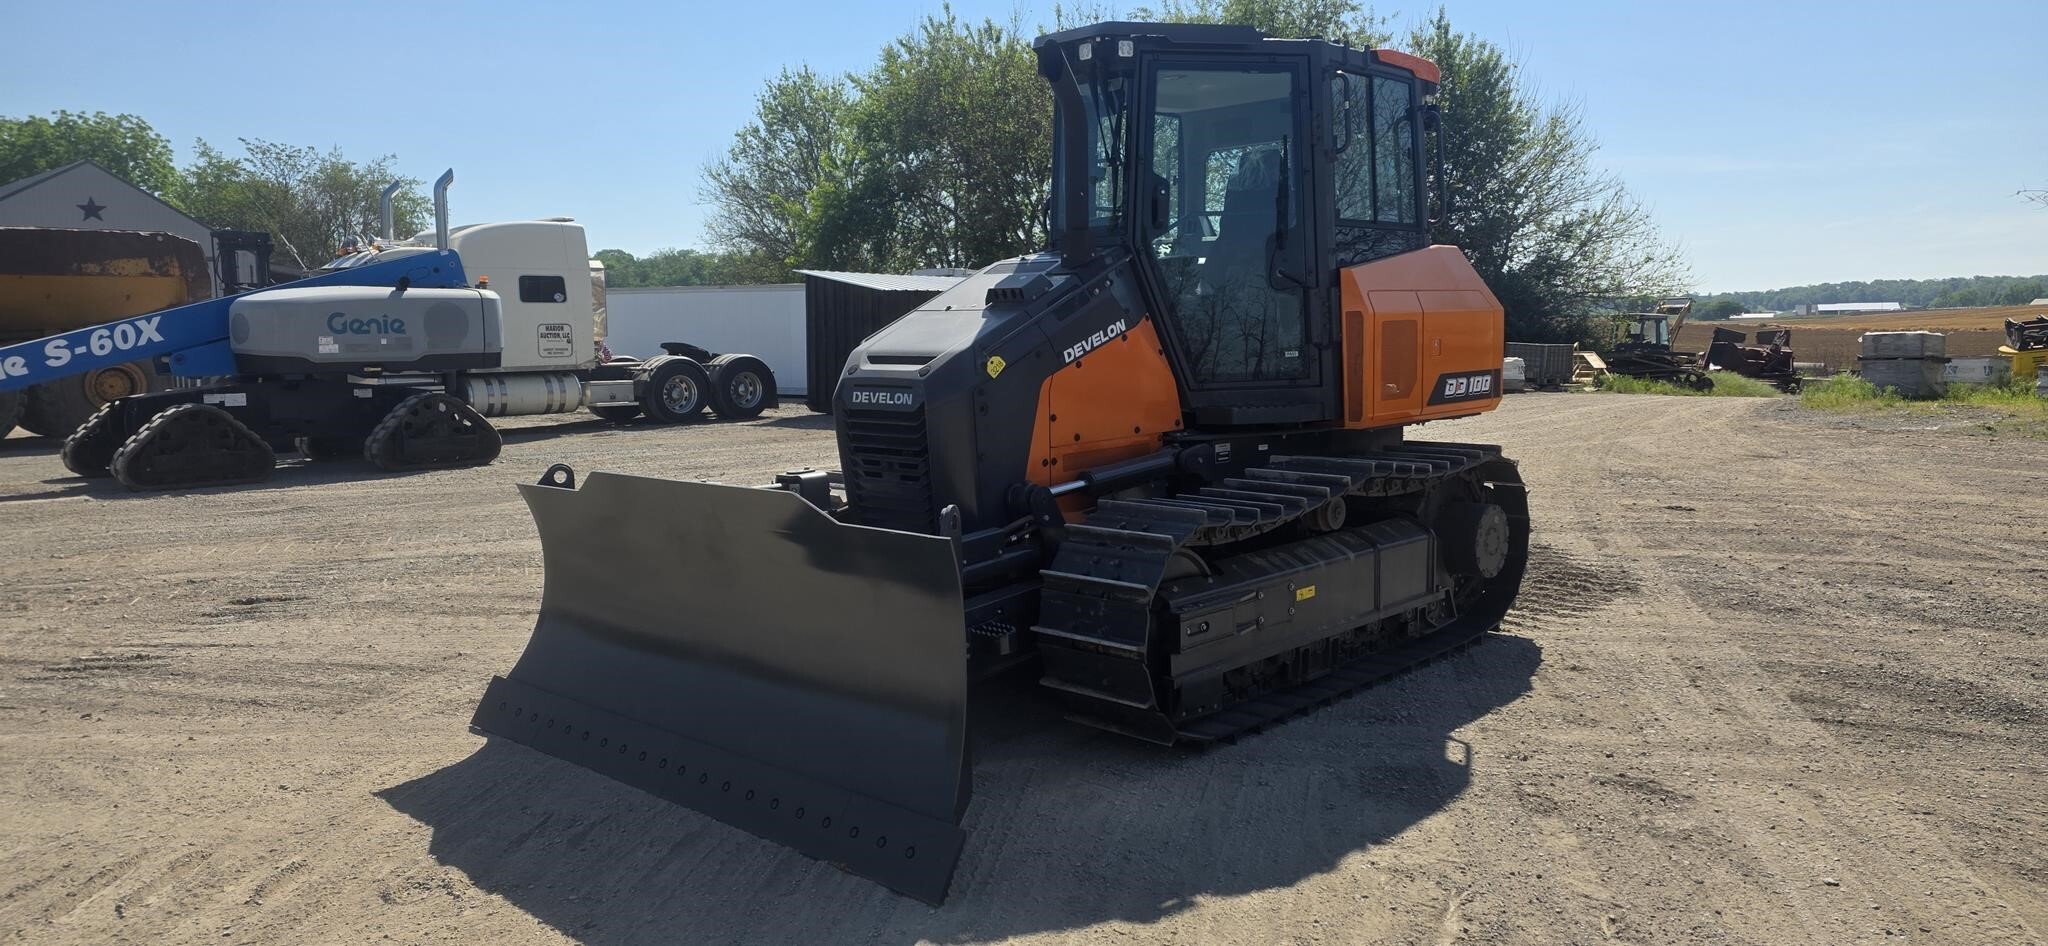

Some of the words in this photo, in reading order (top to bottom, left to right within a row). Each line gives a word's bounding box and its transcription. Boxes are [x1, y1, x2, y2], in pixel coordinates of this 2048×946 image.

[326, 312, 406, 335] Genie
[1063, 318, 1127, 363] DEVELON
[44, 316, 165, 367] S-60X
[852, 391, 913, 405] DEVELON
